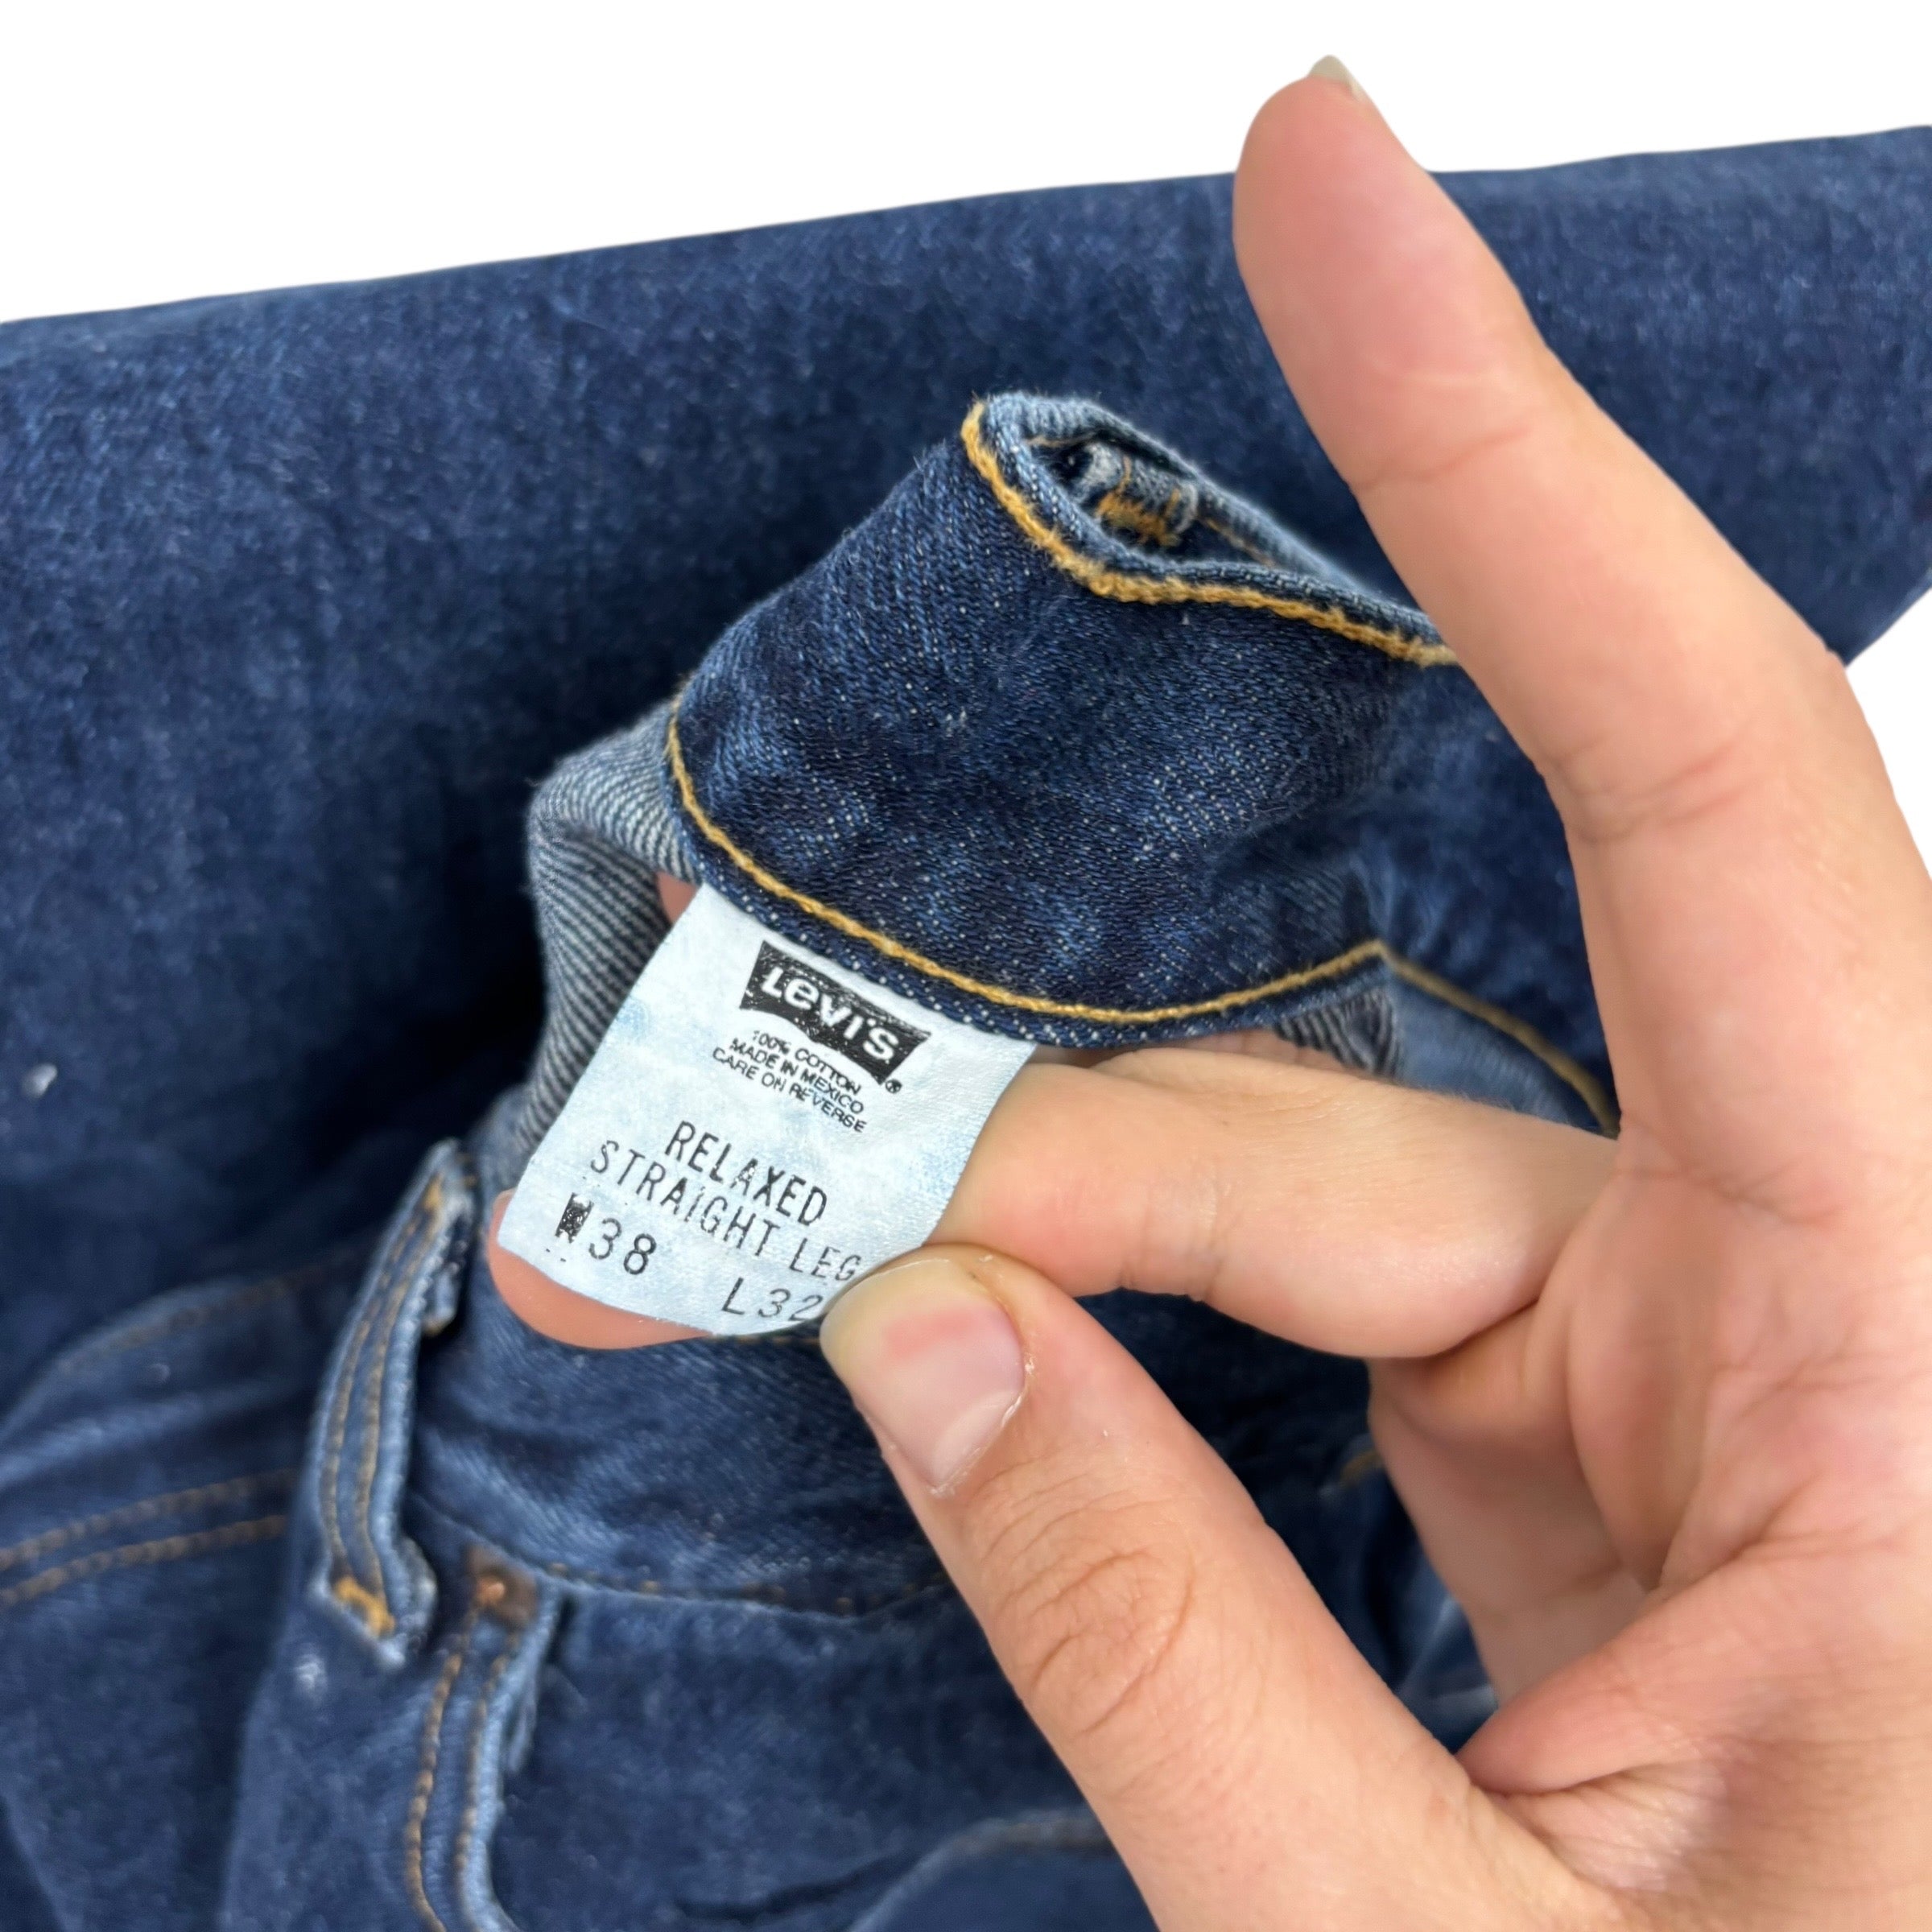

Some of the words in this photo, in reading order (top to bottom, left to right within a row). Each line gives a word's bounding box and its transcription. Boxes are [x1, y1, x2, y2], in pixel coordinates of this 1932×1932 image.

[712, 1048, 756, 1080] CARE
[761, 1073, 786, 1092] ON
[790, 1084, 867, 1133] REVERSE
[730, 1038, 778, 1068] MADE
[781, 1059, 799, 1077] IN
[801, 1069, 864, 1114] MEXICO
[753, 1030, 791, 1055] 100%
[795, 1048, 861, 1096] COTTON
[589, 1140, 781, 1257] STRAIGHT
[789, 1237, 861, 1282] LEG
[664, 1121, 828, 1227] RELAXED
[721, 1277, 823, 1322] L32
